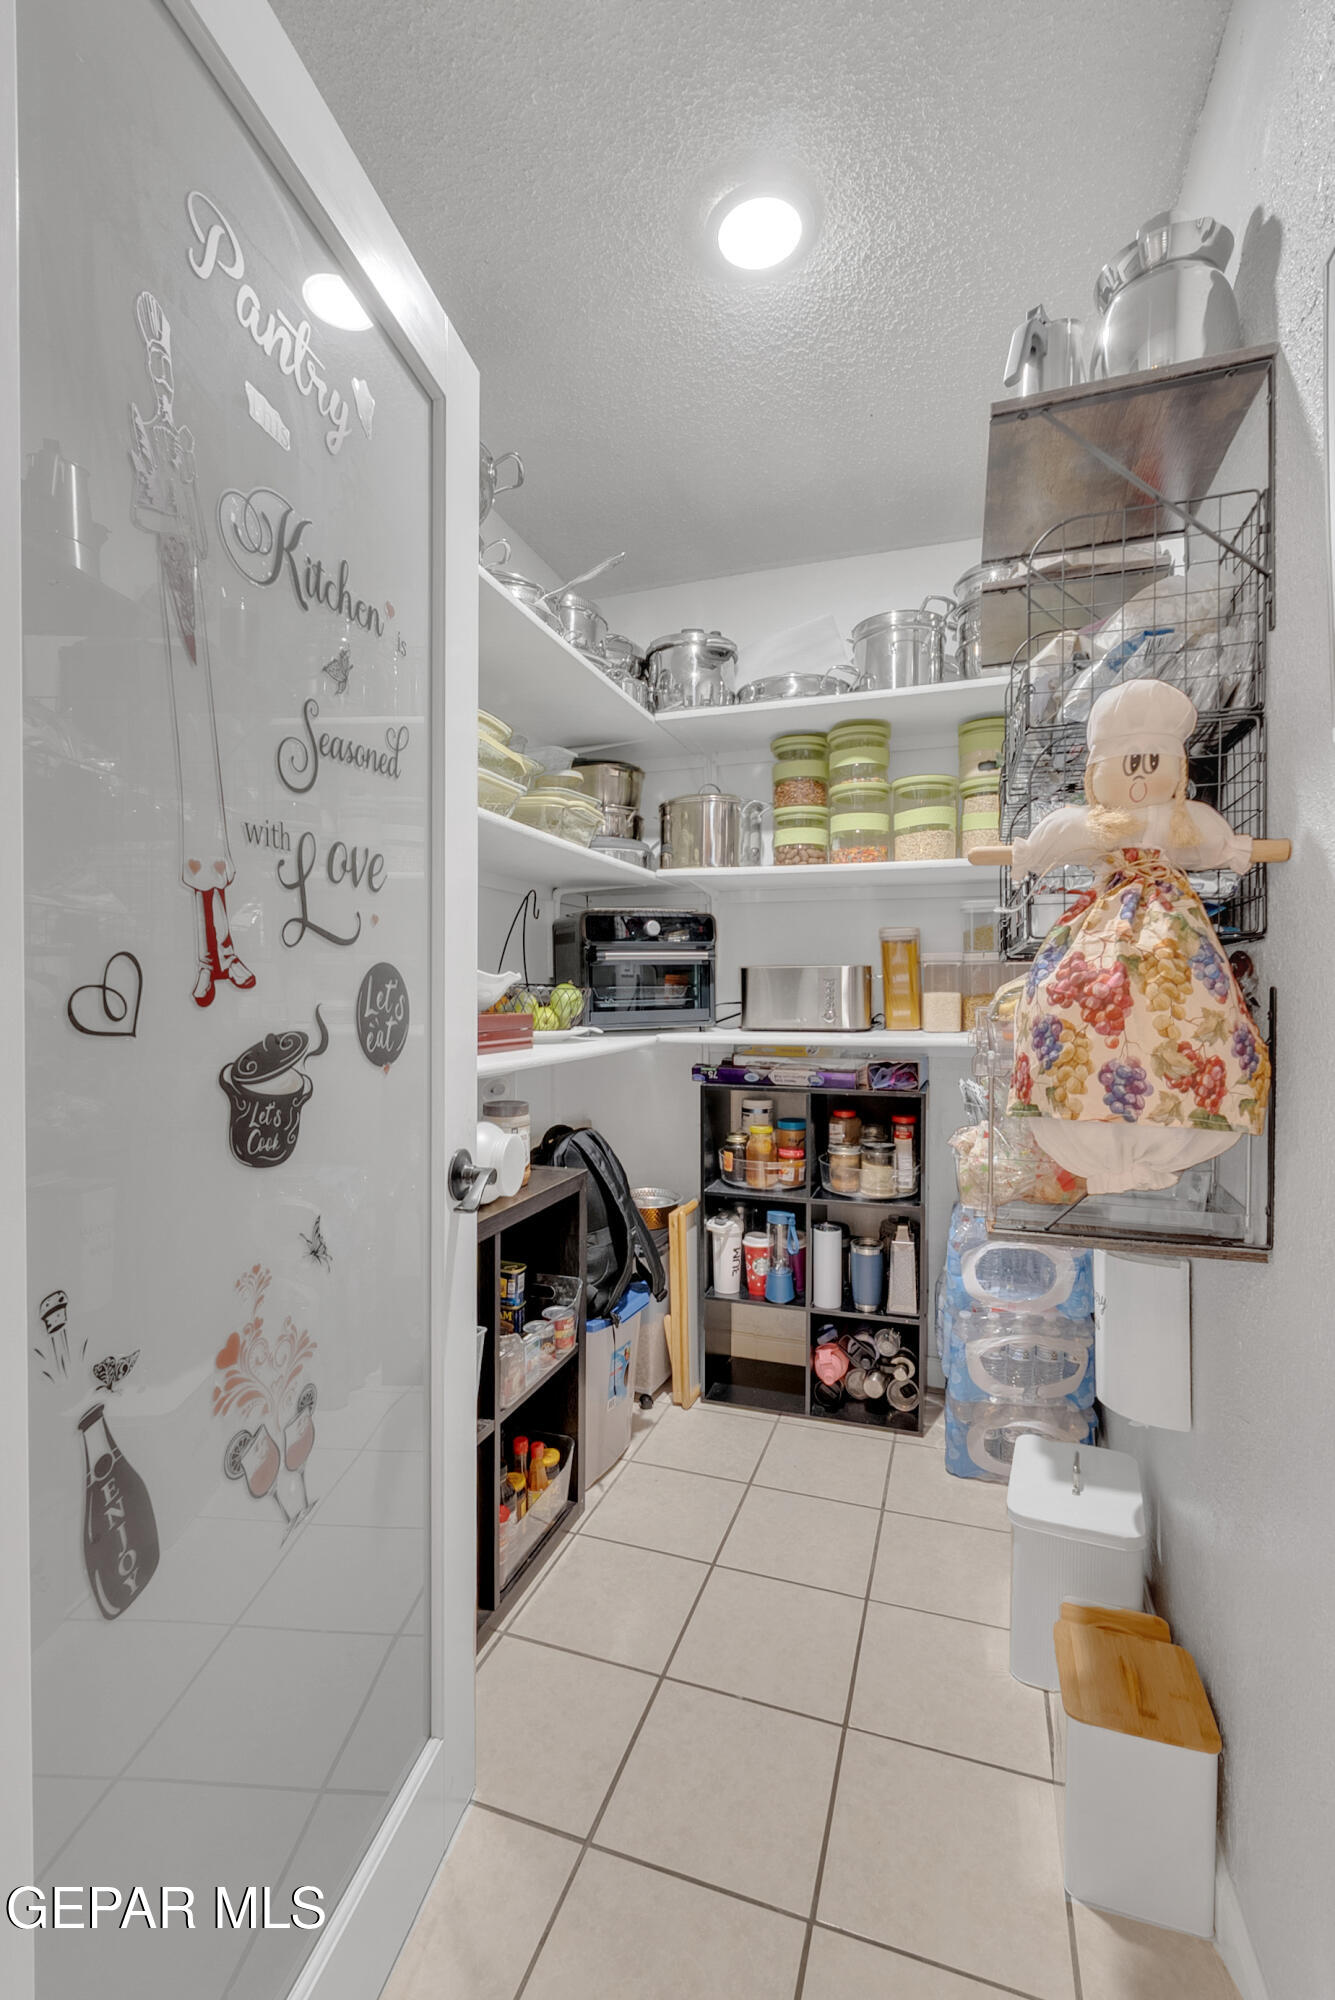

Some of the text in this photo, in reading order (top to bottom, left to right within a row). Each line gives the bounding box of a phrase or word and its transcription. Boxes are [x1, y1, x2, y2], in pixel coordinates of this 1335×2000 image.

[186, 190, 351, 455] Pantry
[218, 489, 384, 637] Kitchen
[277, 698, 409, 793] Seasoned
[244, 819, 388, 948] with Love
[363, 975, 405, 1021] Let's
[366, 1017, 399, 1053] eat
[247, 1128, 281, 1155] Cook
[248, 1101, 282, 1128] Let's
[101, 1477, 140, 1596] ENJOY
